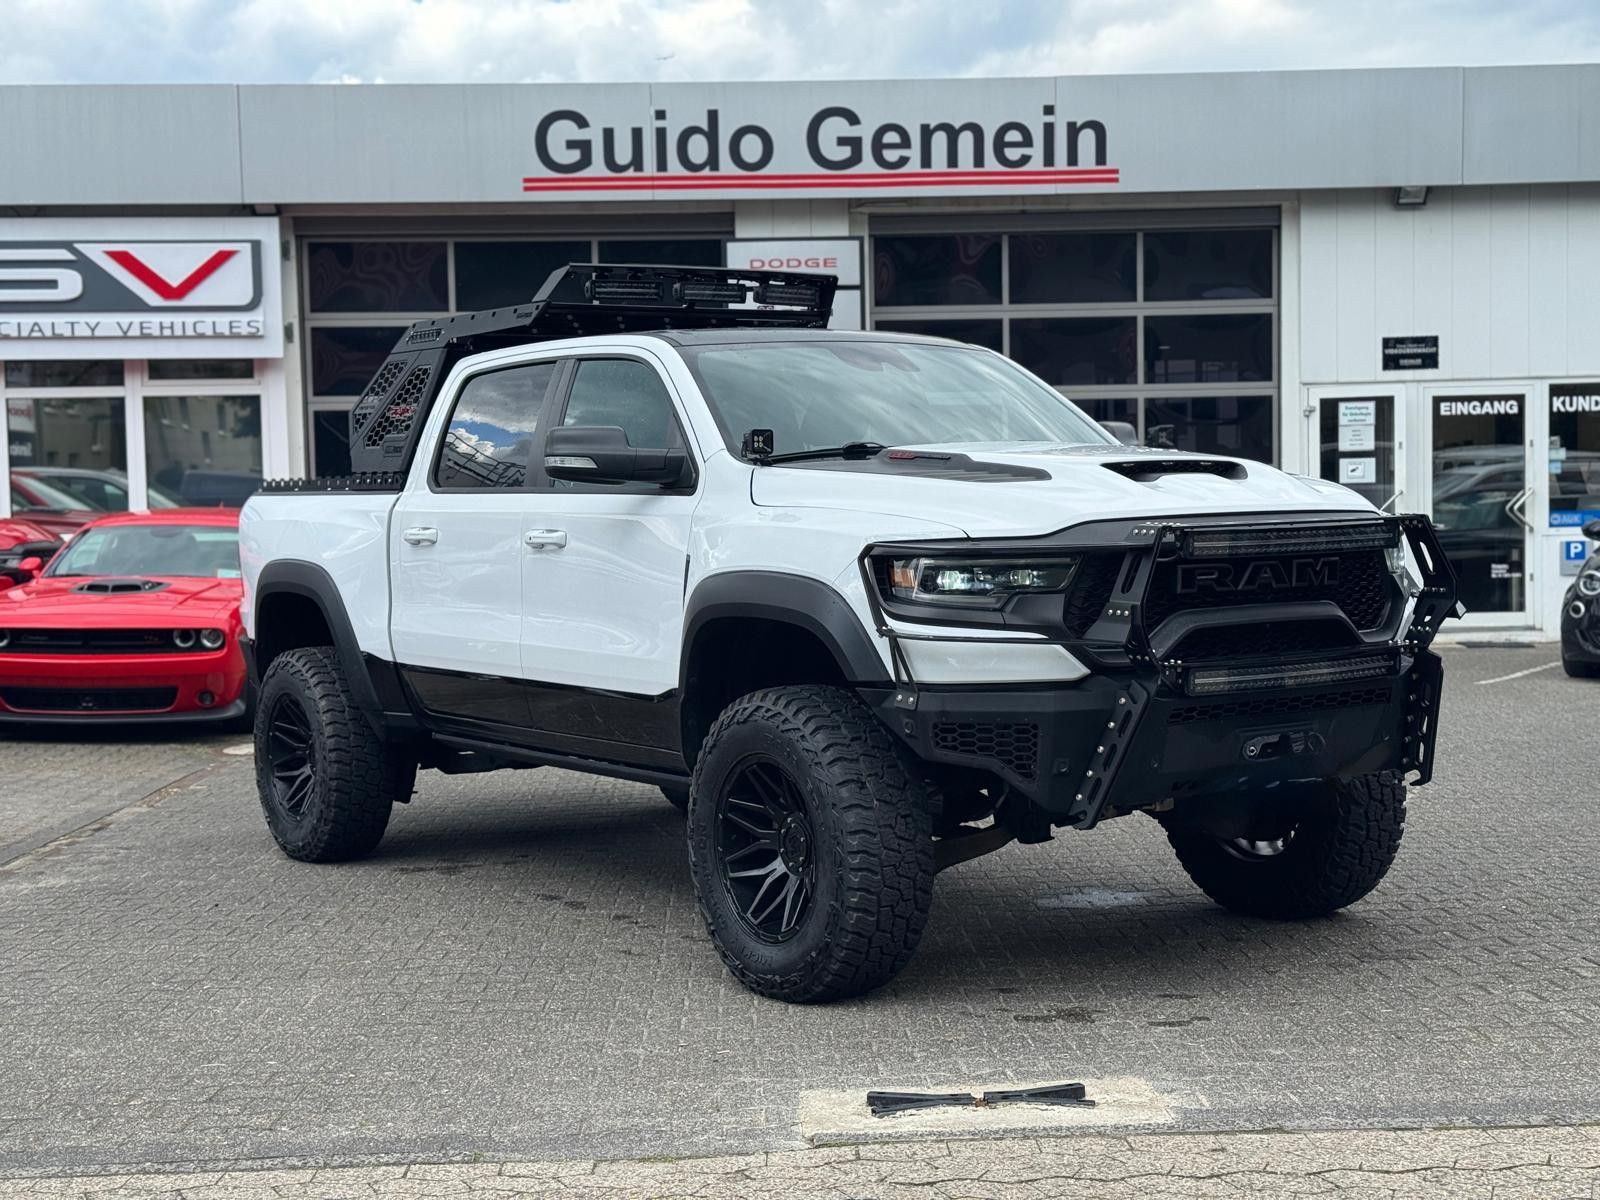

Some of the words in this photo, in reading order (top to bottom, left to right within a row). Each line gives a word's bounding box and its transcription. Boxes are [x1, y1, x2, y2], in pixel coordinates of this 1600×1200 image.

[535, 109, 774, 174] Guido
[806, 105, 1107, 170] Gemein
[750, 258, 837, 268] DODGE
[0, 321, 100, 337] CIALTY
[116, 320, 261, 336] VEHICLES
[1440, 400, 1518, 415] EINGANG
[1552, 396, 1600, 412] KUND
[1570, 543, 1582, 558] P
[1176, 556, 1340, 594] RAM
